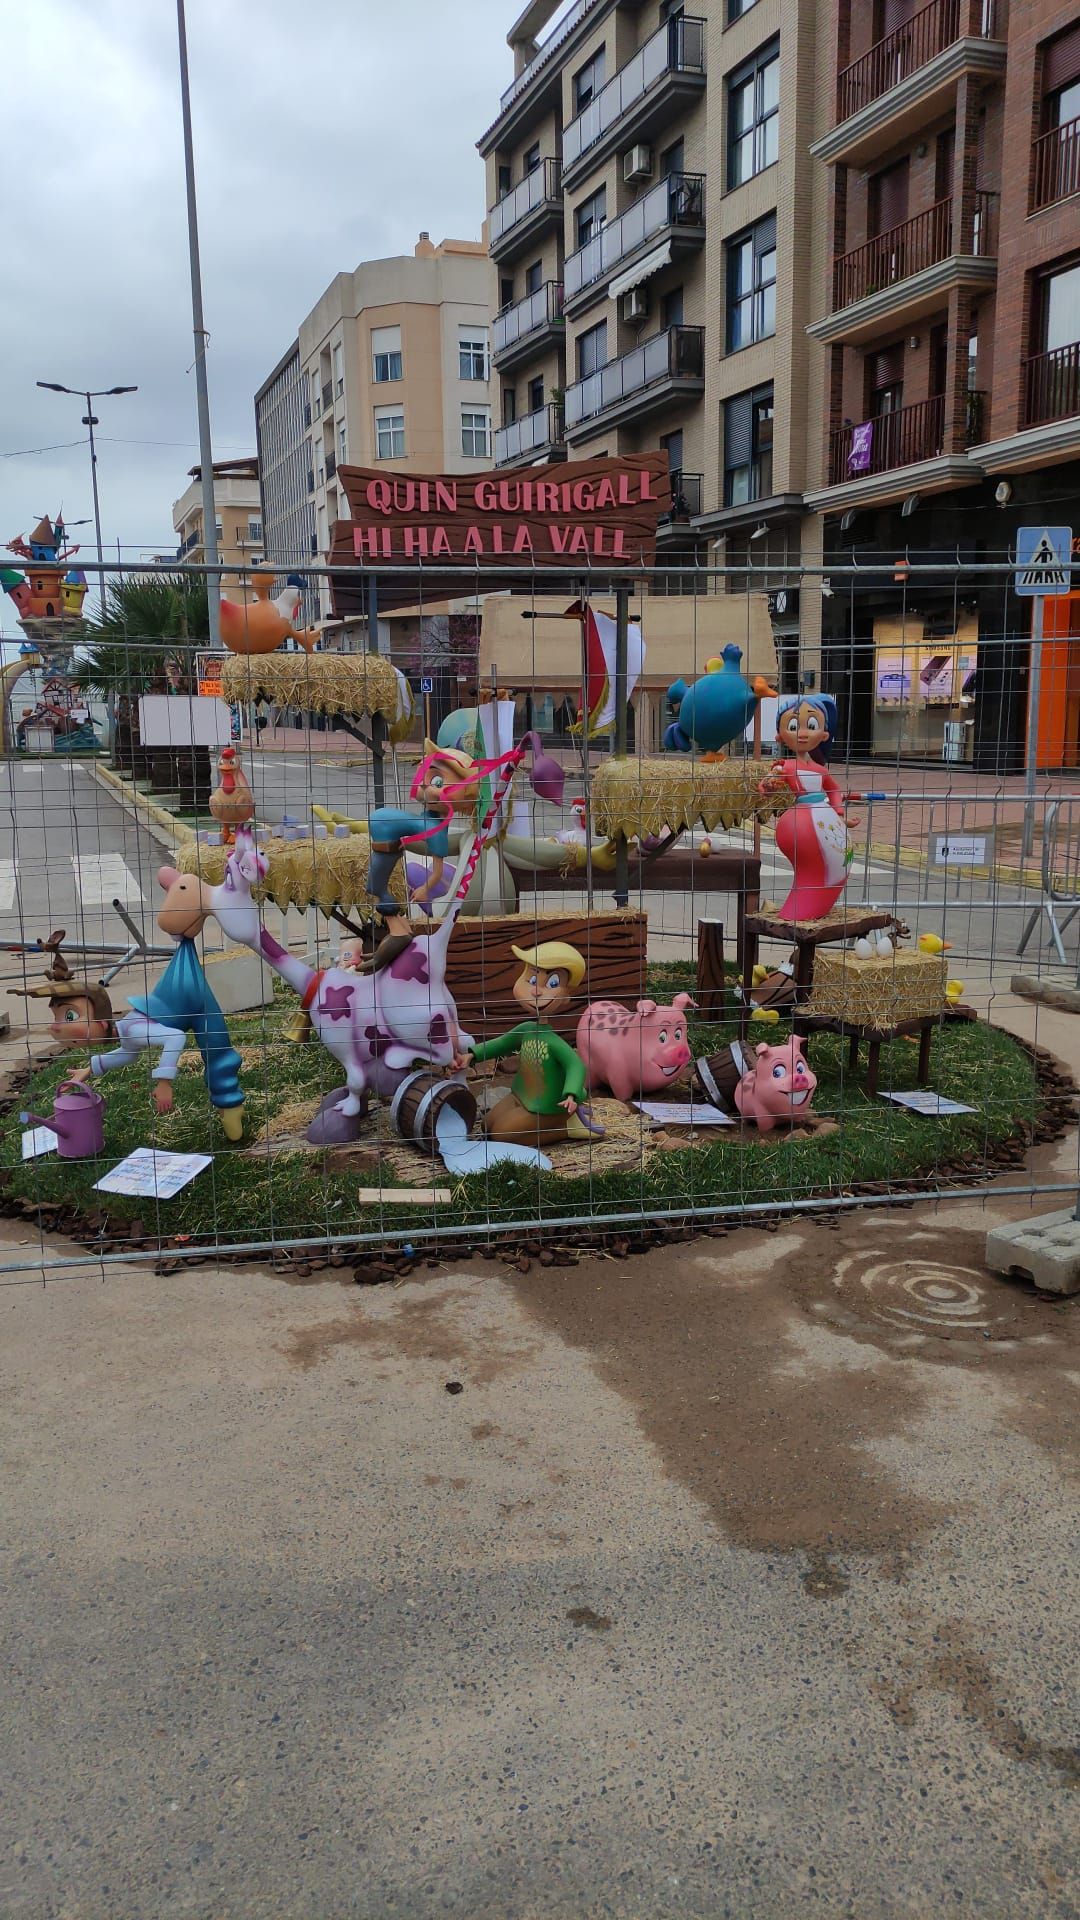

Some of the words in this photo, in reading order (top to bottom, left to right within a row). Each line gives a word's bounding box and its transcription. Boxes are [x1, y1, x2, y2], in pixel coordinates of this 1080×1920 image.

[366, 479, 457, 515] QUIN
[474, 470, 658, 513] GUIRIGALL
[353, 527, 392, 557] HI
[403, 526, 453, 557] HA
[464, 526, 484, 556] A
[493, 525, 533, 555] LA
[549, 525, 632, 559] VALL
